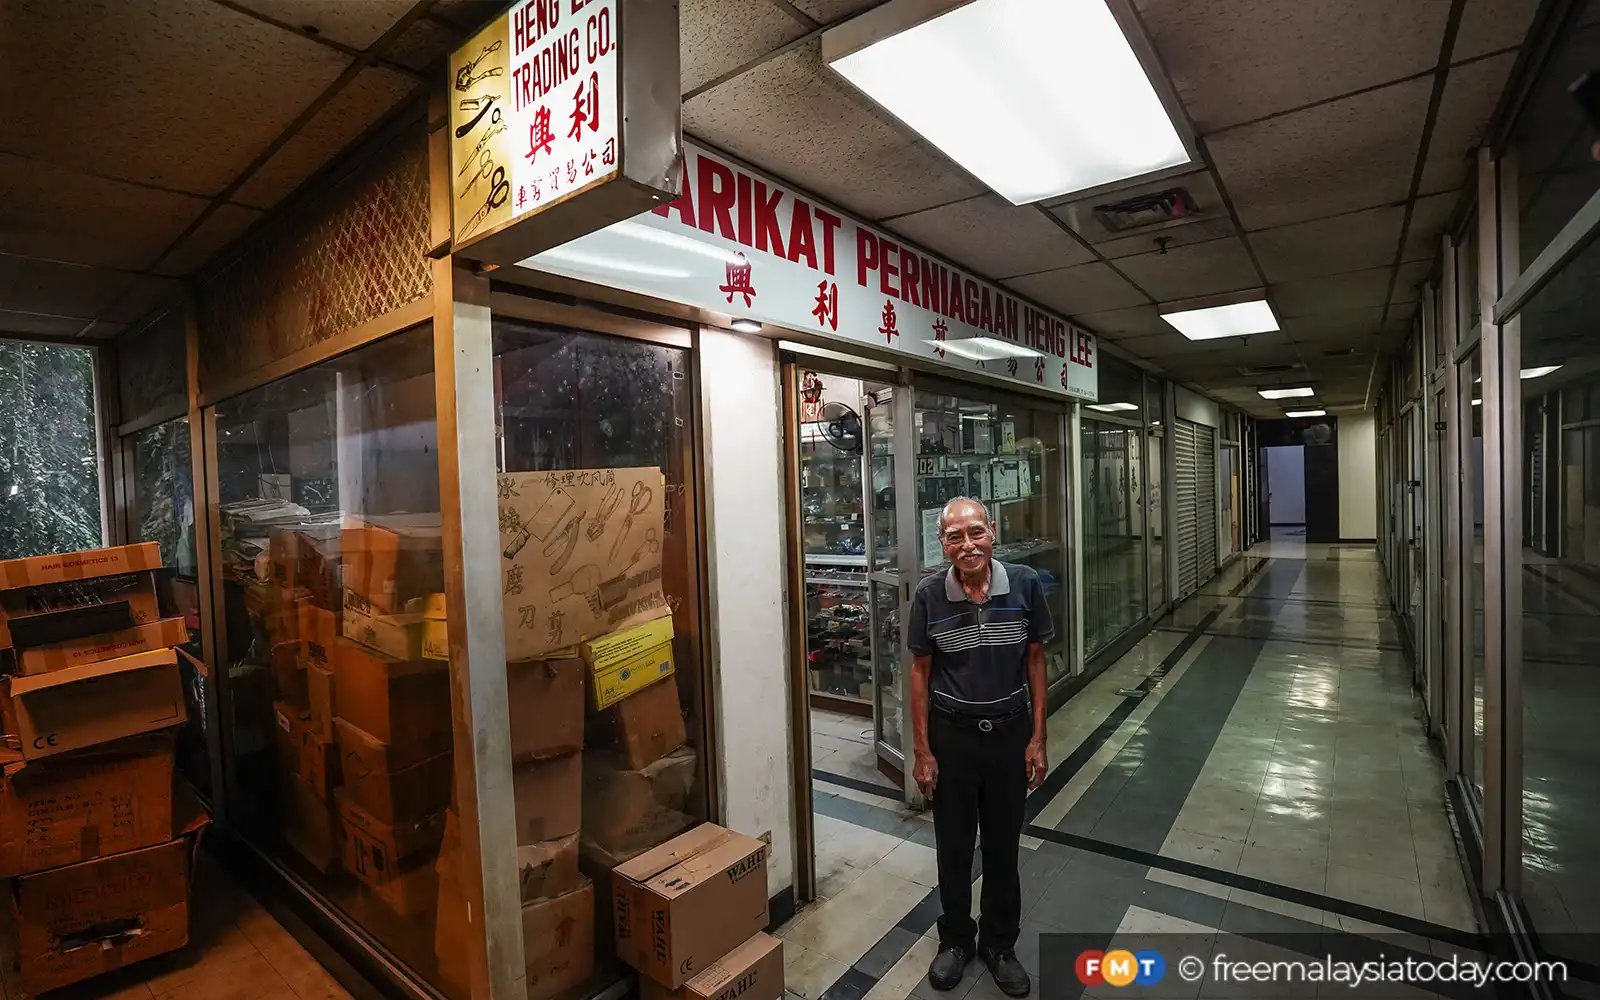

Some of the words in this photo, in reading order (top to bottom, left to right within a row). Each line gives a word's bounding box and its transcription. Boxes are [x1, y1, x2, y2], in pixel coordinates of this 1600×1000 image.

[514, 0, 560, 56] HENG
[513, 27, 580, 112] TRADING
[586, 6, 616, 64] CO.
[857, 226, 1018, 342] PERNIAGAAN
[1024, 306, 1065, 359] HENG
[1069, 322, 1092, 369] LEE
[42, 561, 62, 571] HAIR
[62, 556, 109, 568] COSMETICS
[33, 733, 58, 750] CE
[727, 848, 765, 881] WAHL
[655, 909, 667, 961] WAHL
[680, 956, 693, 975] CE
